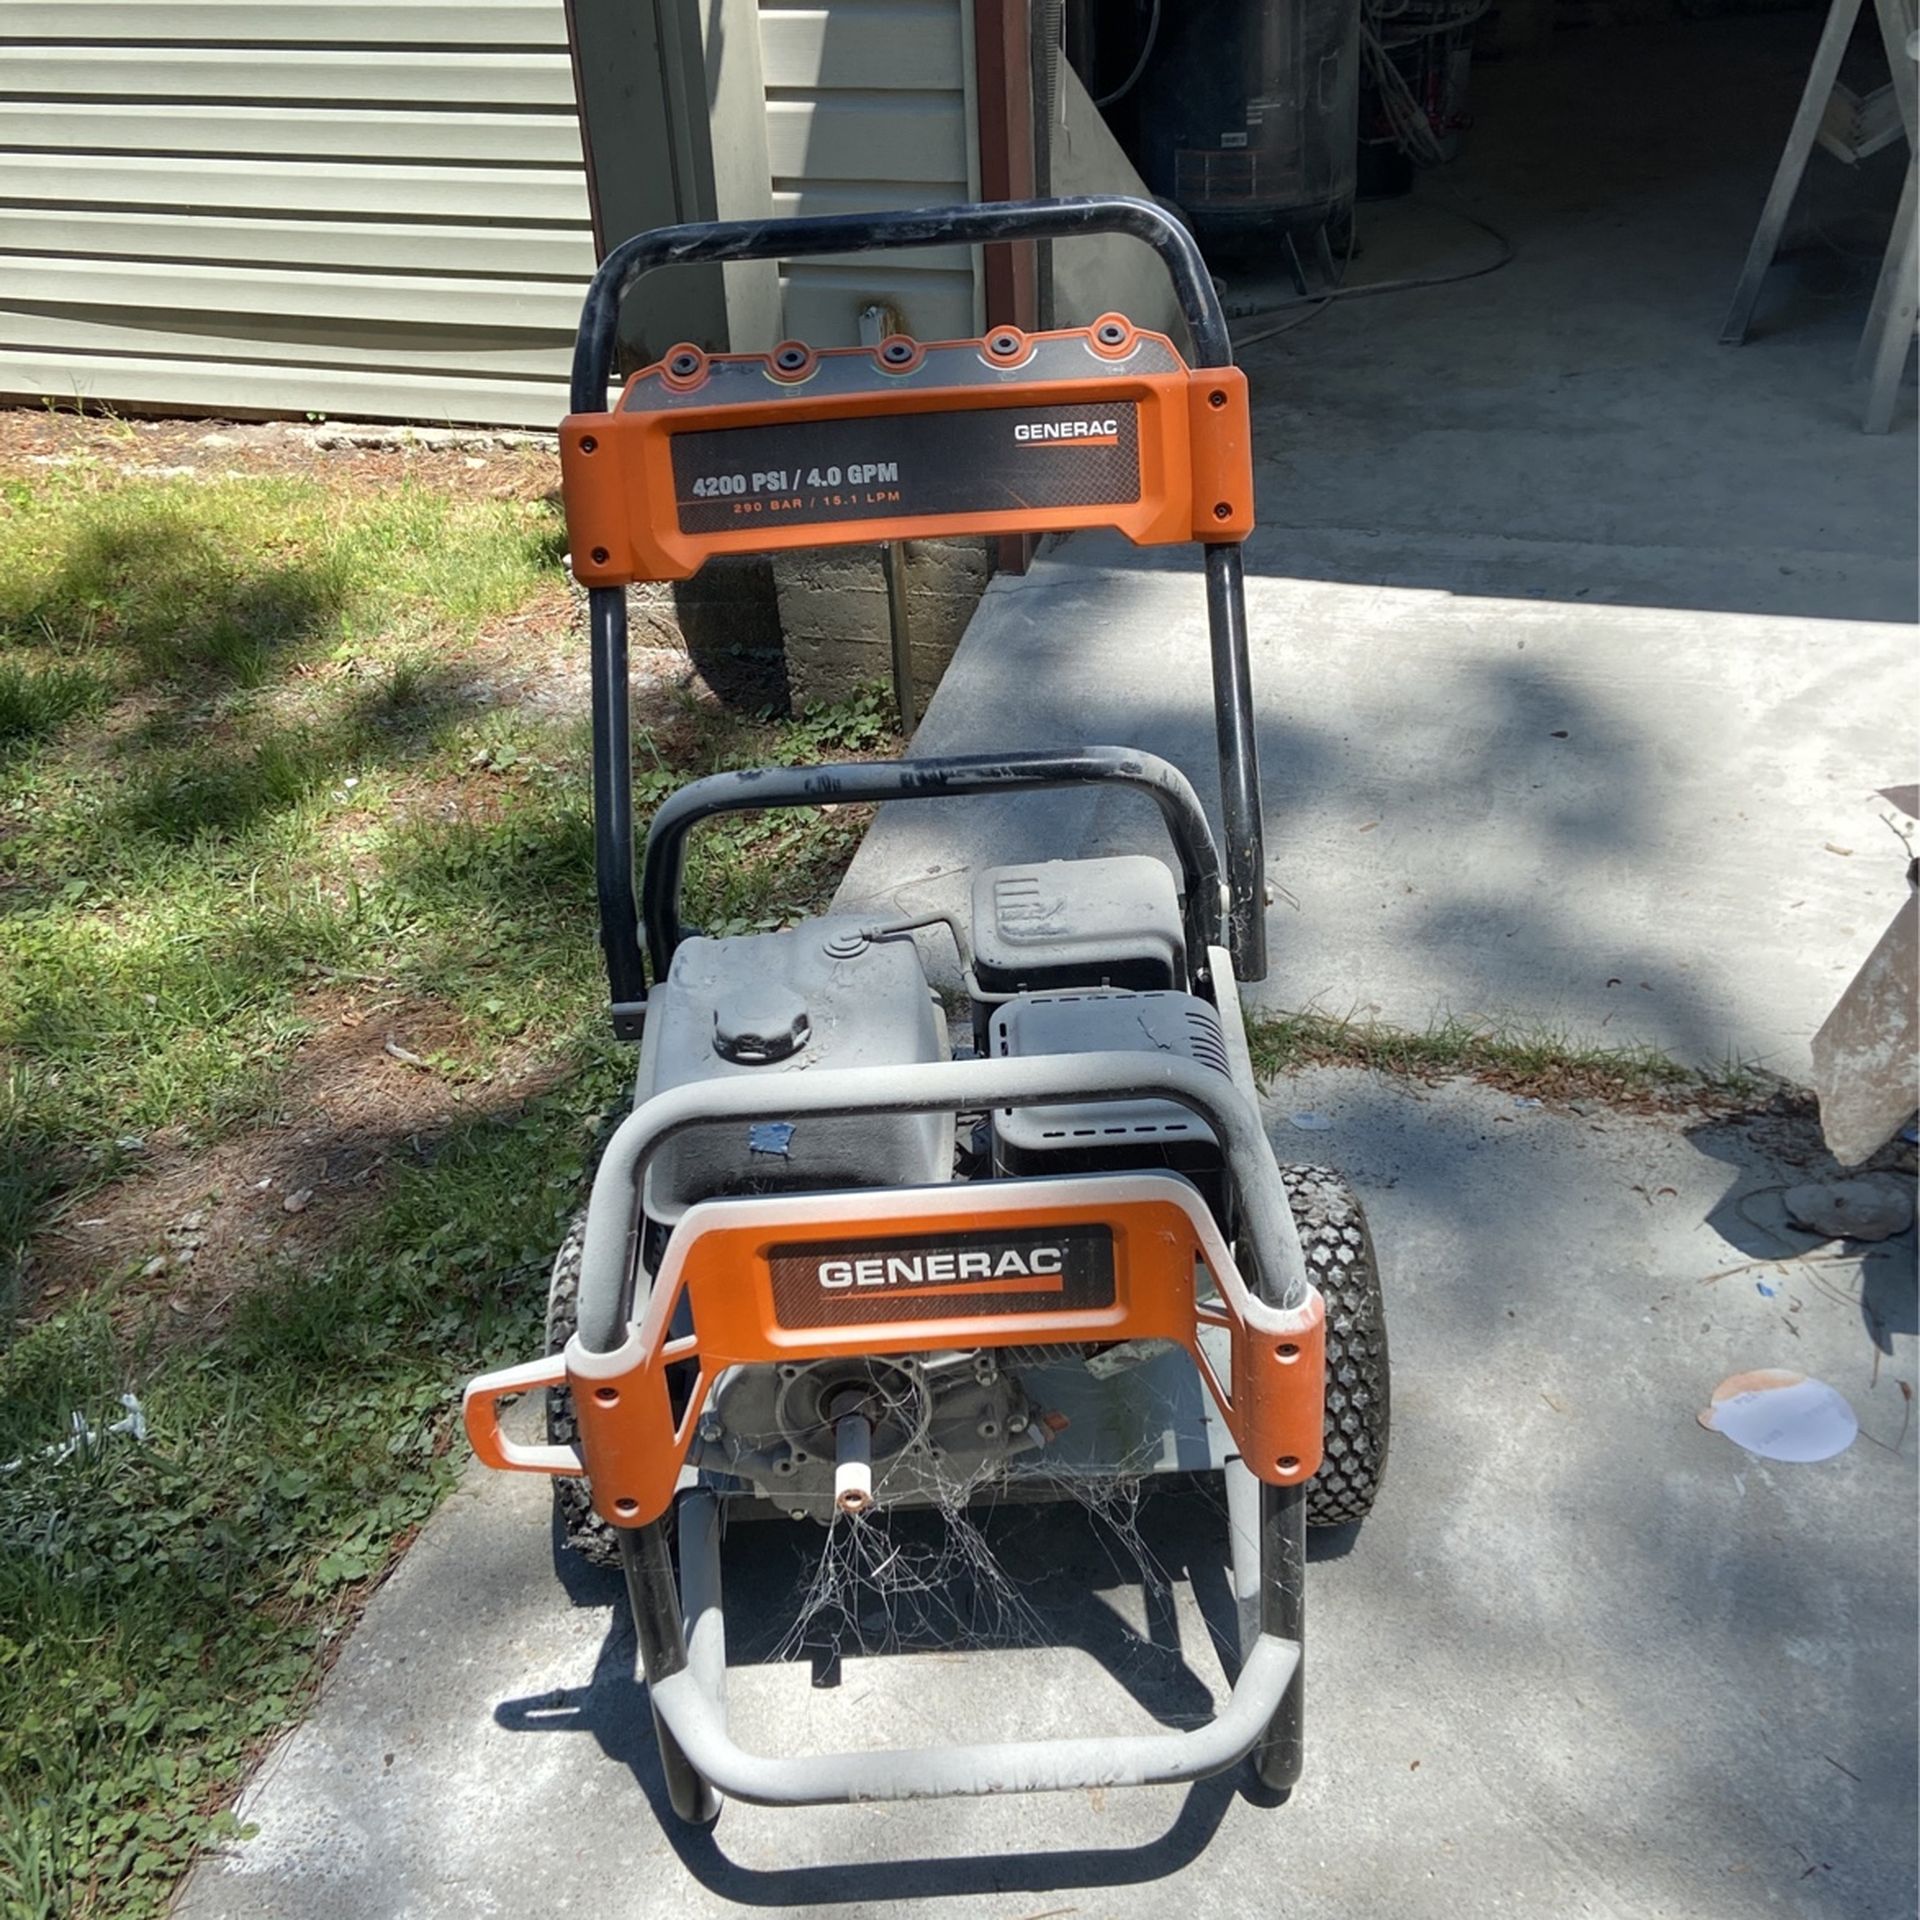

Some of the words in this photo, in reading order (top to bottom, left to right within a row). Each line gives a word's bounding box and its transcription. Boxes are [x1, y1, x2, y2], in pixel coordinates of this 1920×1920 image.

[1014, 419, 1118, 440] GENERAC
[692, 474, 747, 497] 4200
[752, 470, 788, 492] PSI
[793, 469, 801, 491] /
[806, 466, 842, 488] 4.0
[848, 462, 899, 484] GPM
[733, 502, 763, 513] 290
[770, 498, 802, 511] BAR
[810, 498, 816, 508] /
[823, 494, 858, 506] 15.1
[866, 491, 900, 503] LPM
[818, 1247, 1063, 1289] GENERAC
